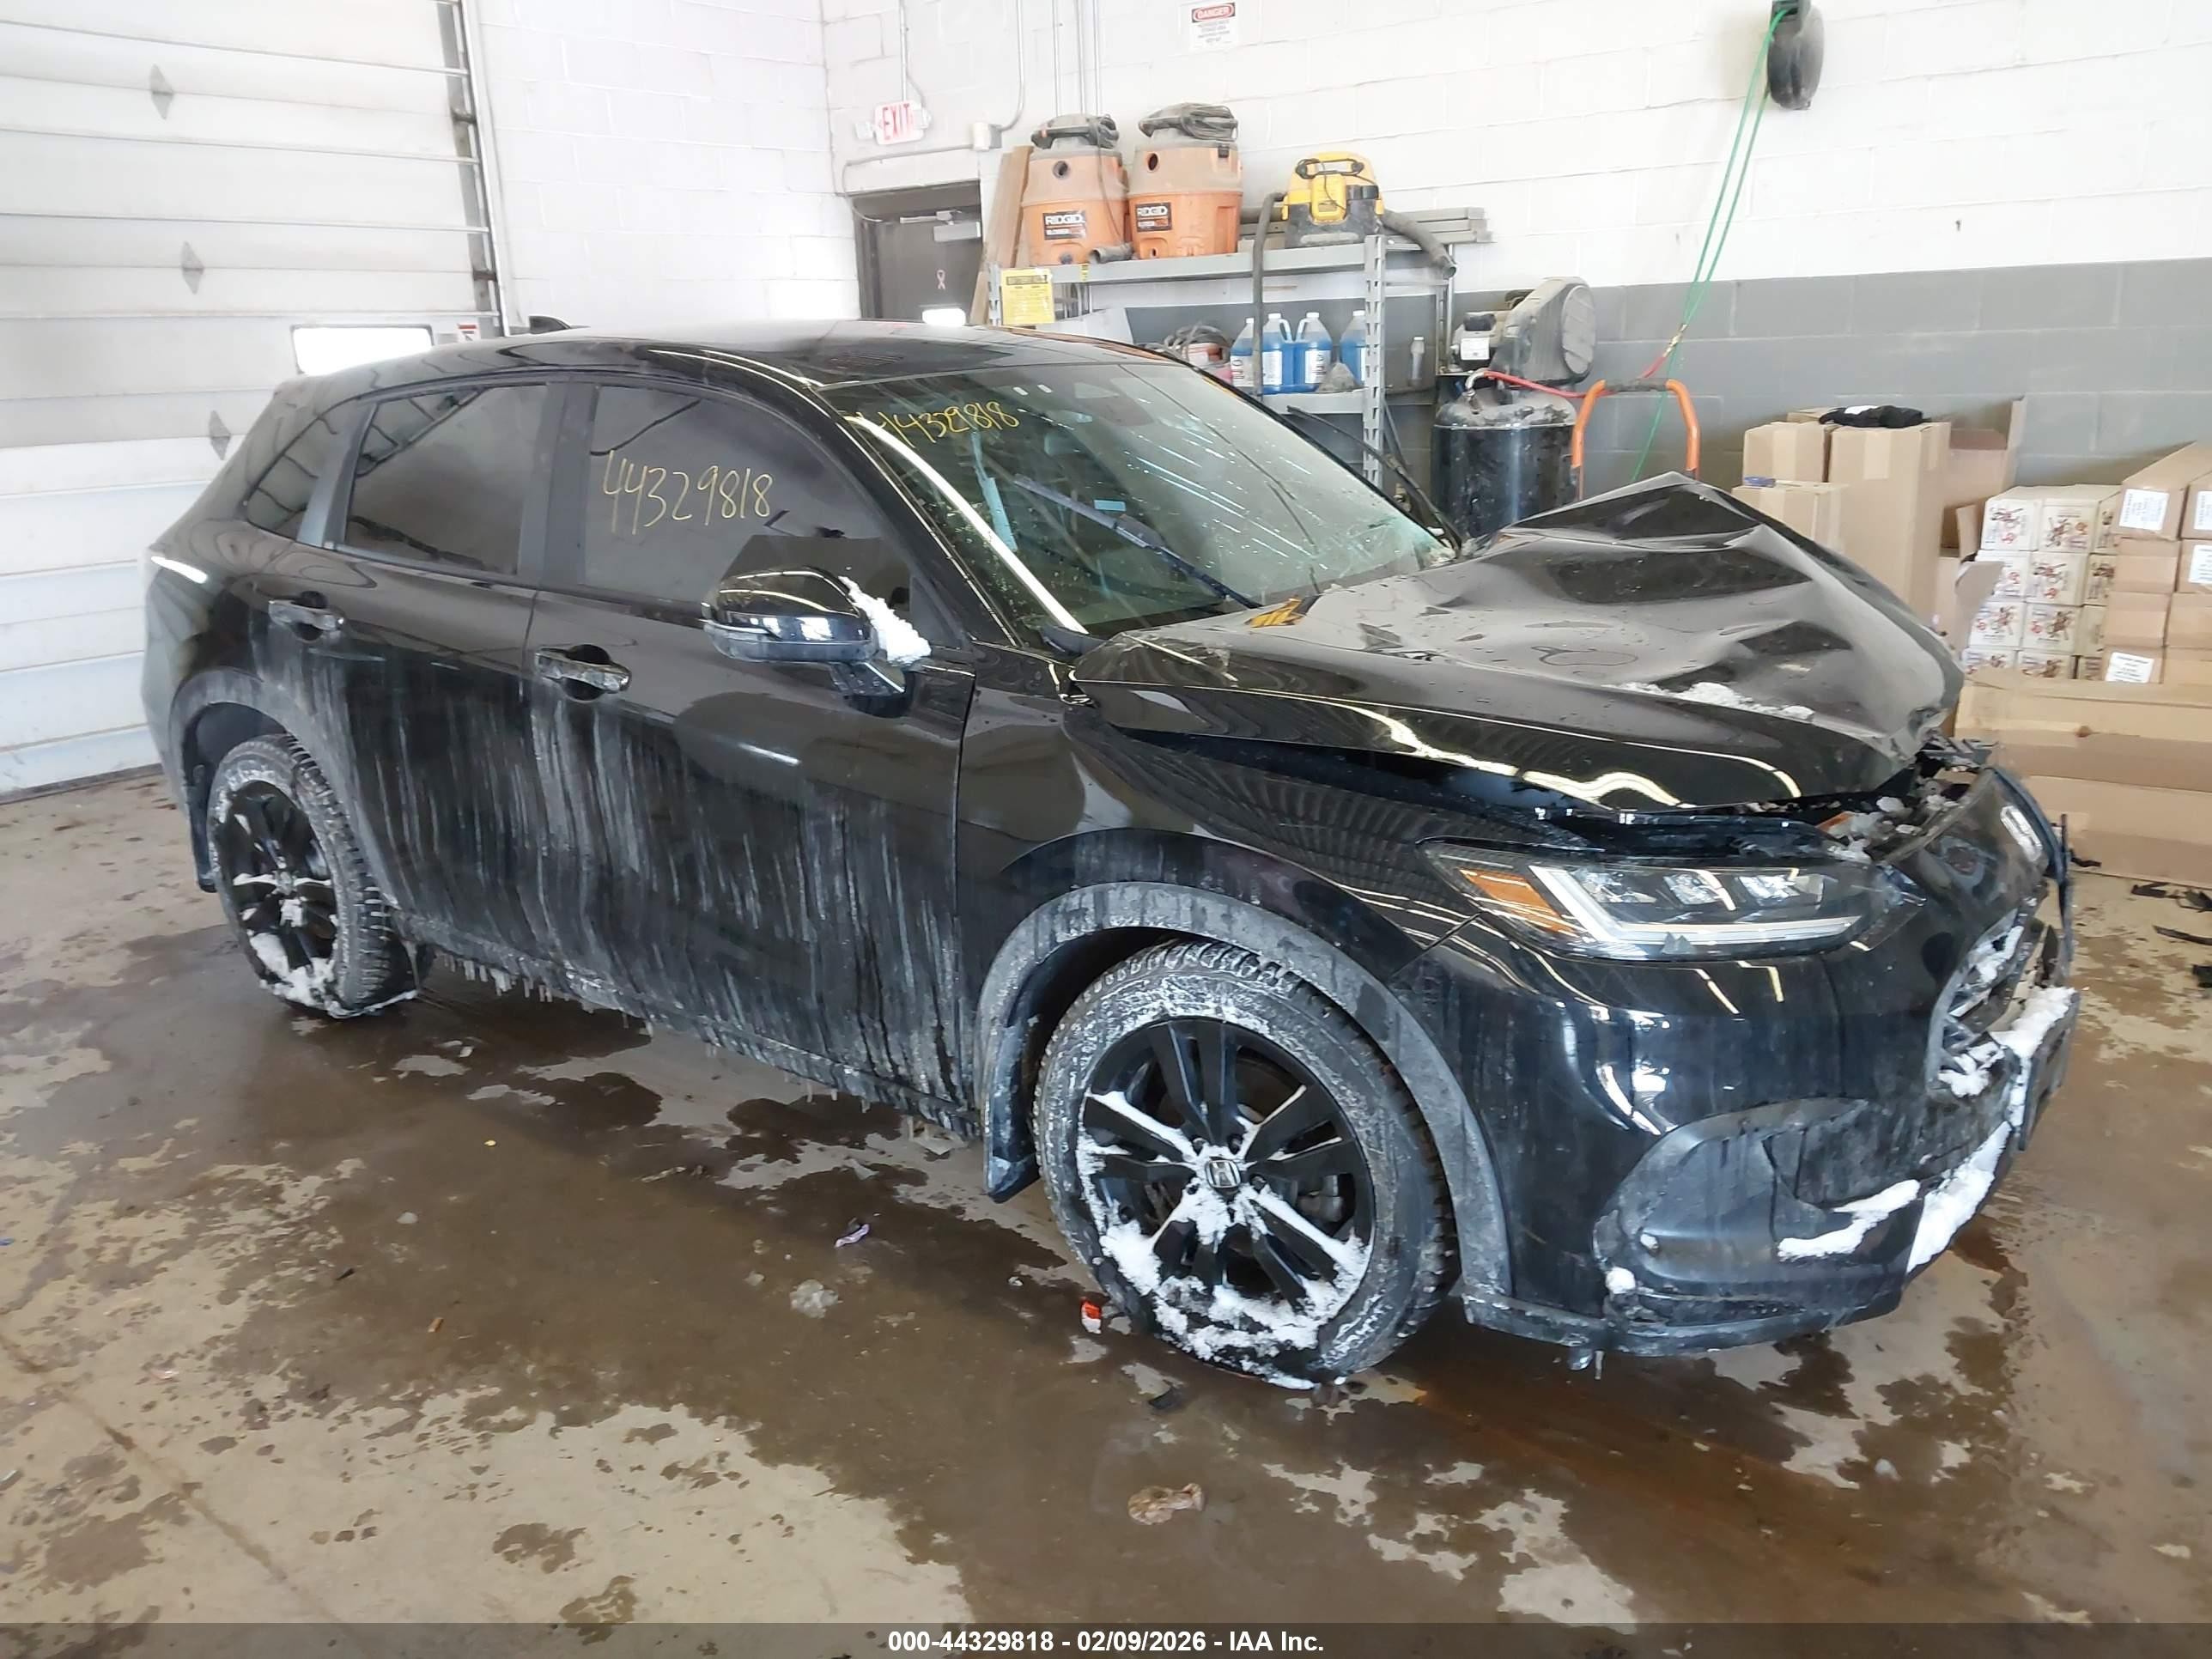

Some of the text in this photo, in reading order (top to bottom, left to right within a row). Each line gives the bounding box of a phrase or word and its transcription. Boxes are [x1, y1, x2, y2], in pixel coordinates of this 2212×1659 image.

[1196, 6, 1231, 19] DANGER
[881, 102, 910, 141] EXIT
[604, 450, 773, 536] 44329818
